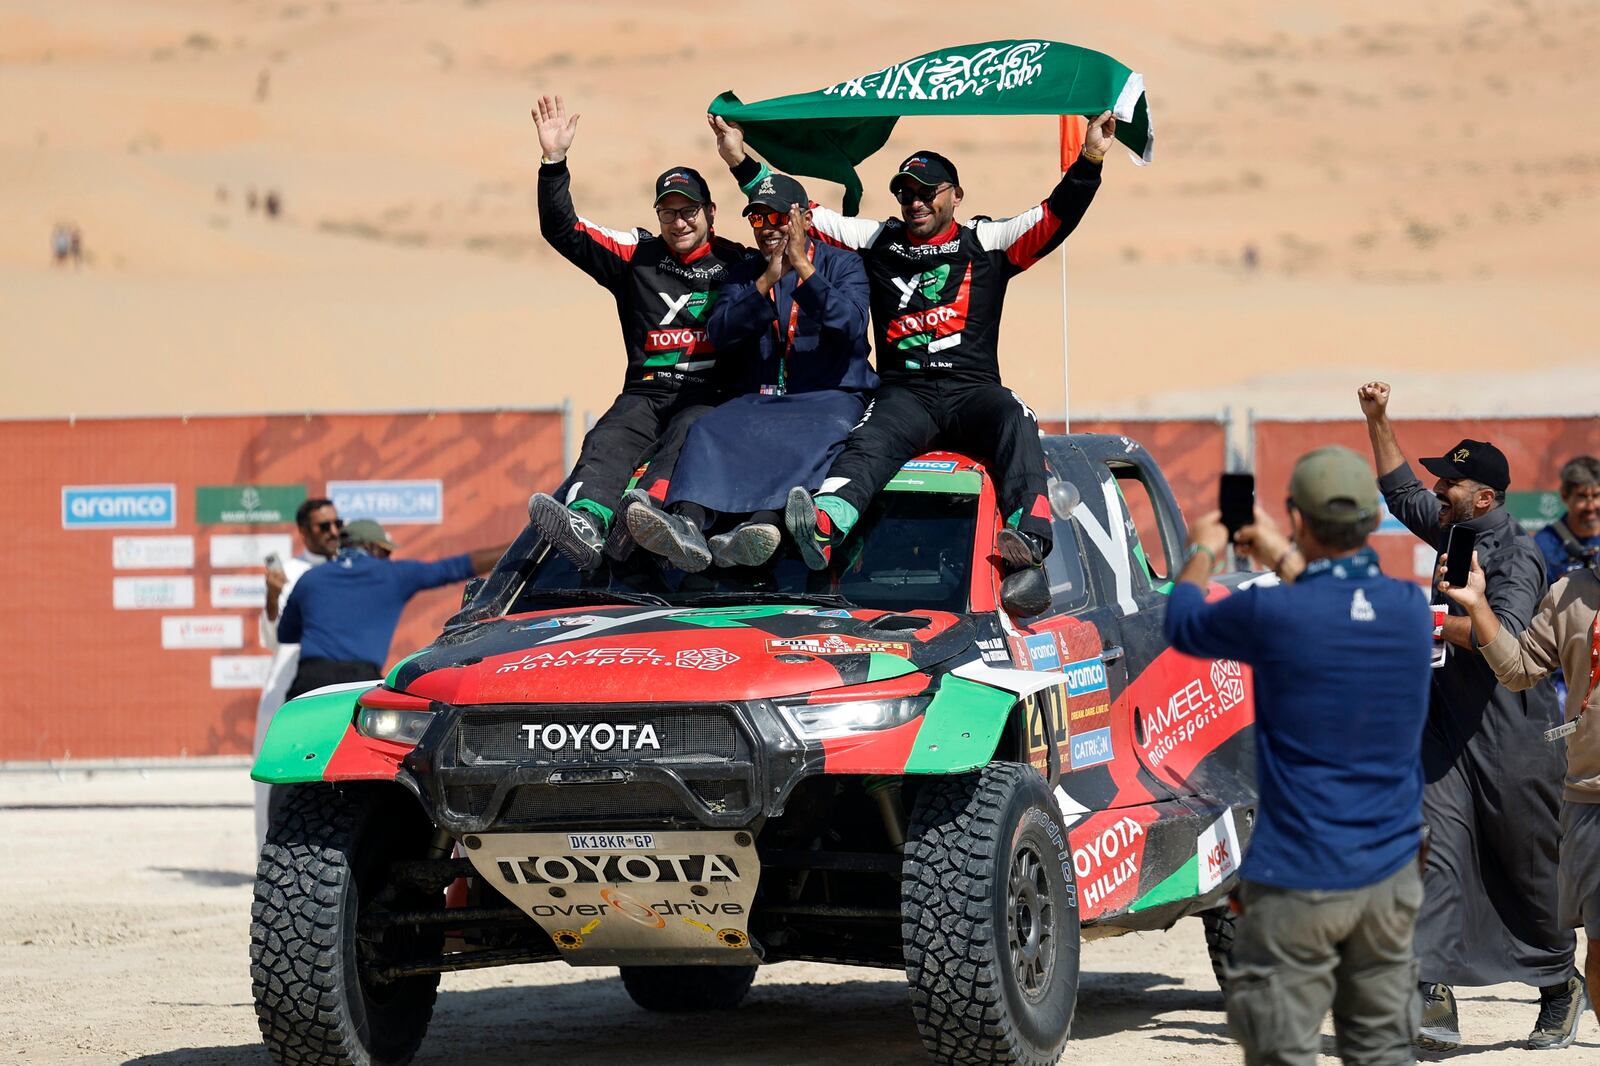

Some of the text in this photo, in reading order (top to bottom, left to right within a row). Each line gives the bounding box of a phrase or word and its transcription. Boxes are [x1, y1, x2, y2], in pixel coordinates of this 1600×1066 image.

[898, 306, 957, 333] TOYOTA
[71, 495, 167, 518] aramco
[504, 647, 666, 666] JAMEEL
[790, 644, 832, 653] SAUDI
[1030, 644, 1056, 660] aramco
[1030, 683, 1067, 748] 21
[1142, 678, 1214, 749] JAMEEL
[522, 723, 661, 751] TOYOTA
[571, 835, 627, 849] DK18KR
[1072, 815, 1144, 878] OYOTA
[1207, 837, 1229, 873] NGK
[496, 854, 742, 885] TOYOTA
